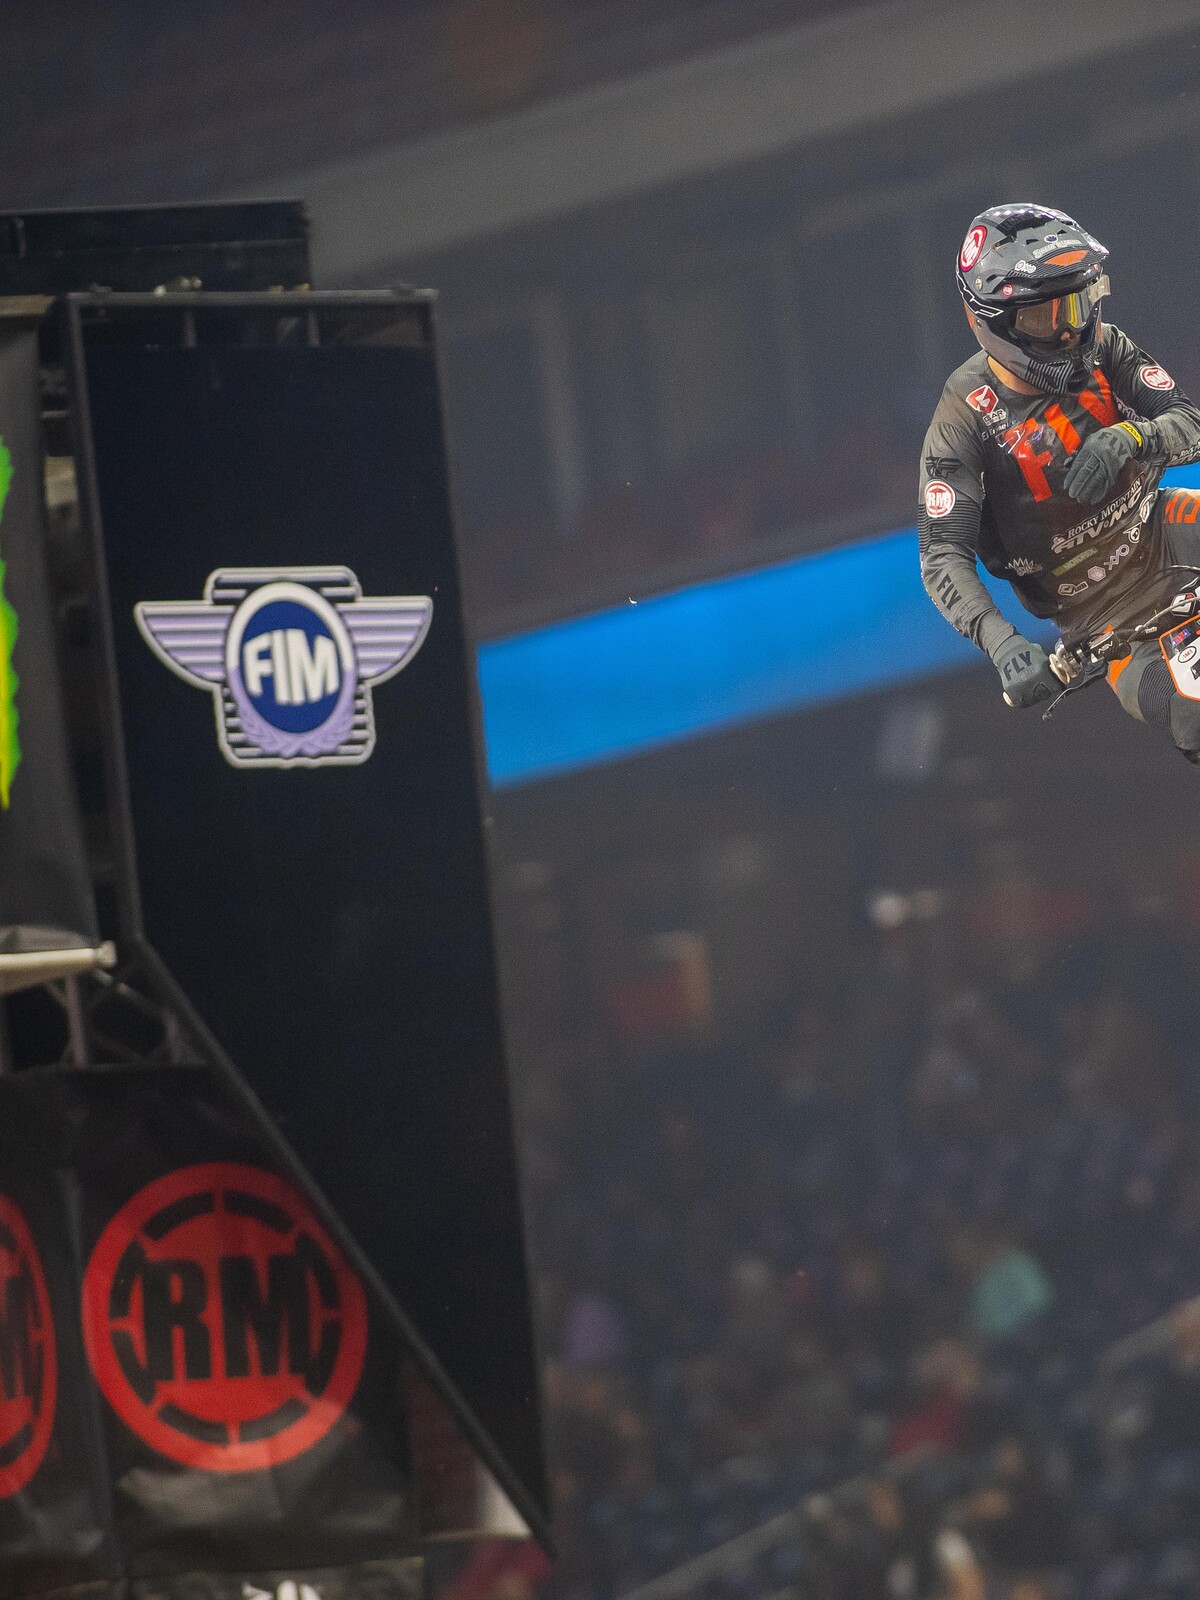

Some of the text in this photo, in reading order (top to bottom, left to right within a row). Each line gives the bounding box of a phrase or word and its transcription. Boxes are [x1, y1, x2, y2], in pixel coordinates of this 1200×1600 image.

[1001, 368, 1121, 502] FLY
[1068, 514, 1099, 539] ROCKY
[1100, 478, 1141, 521] MOUNTAIN
[936, 573, 962, 611] FLY
[243, 628, 340, 706] FIM
[1003, 650, 1033, 682] FLY
[141, 1252, 308, 1384] RM
